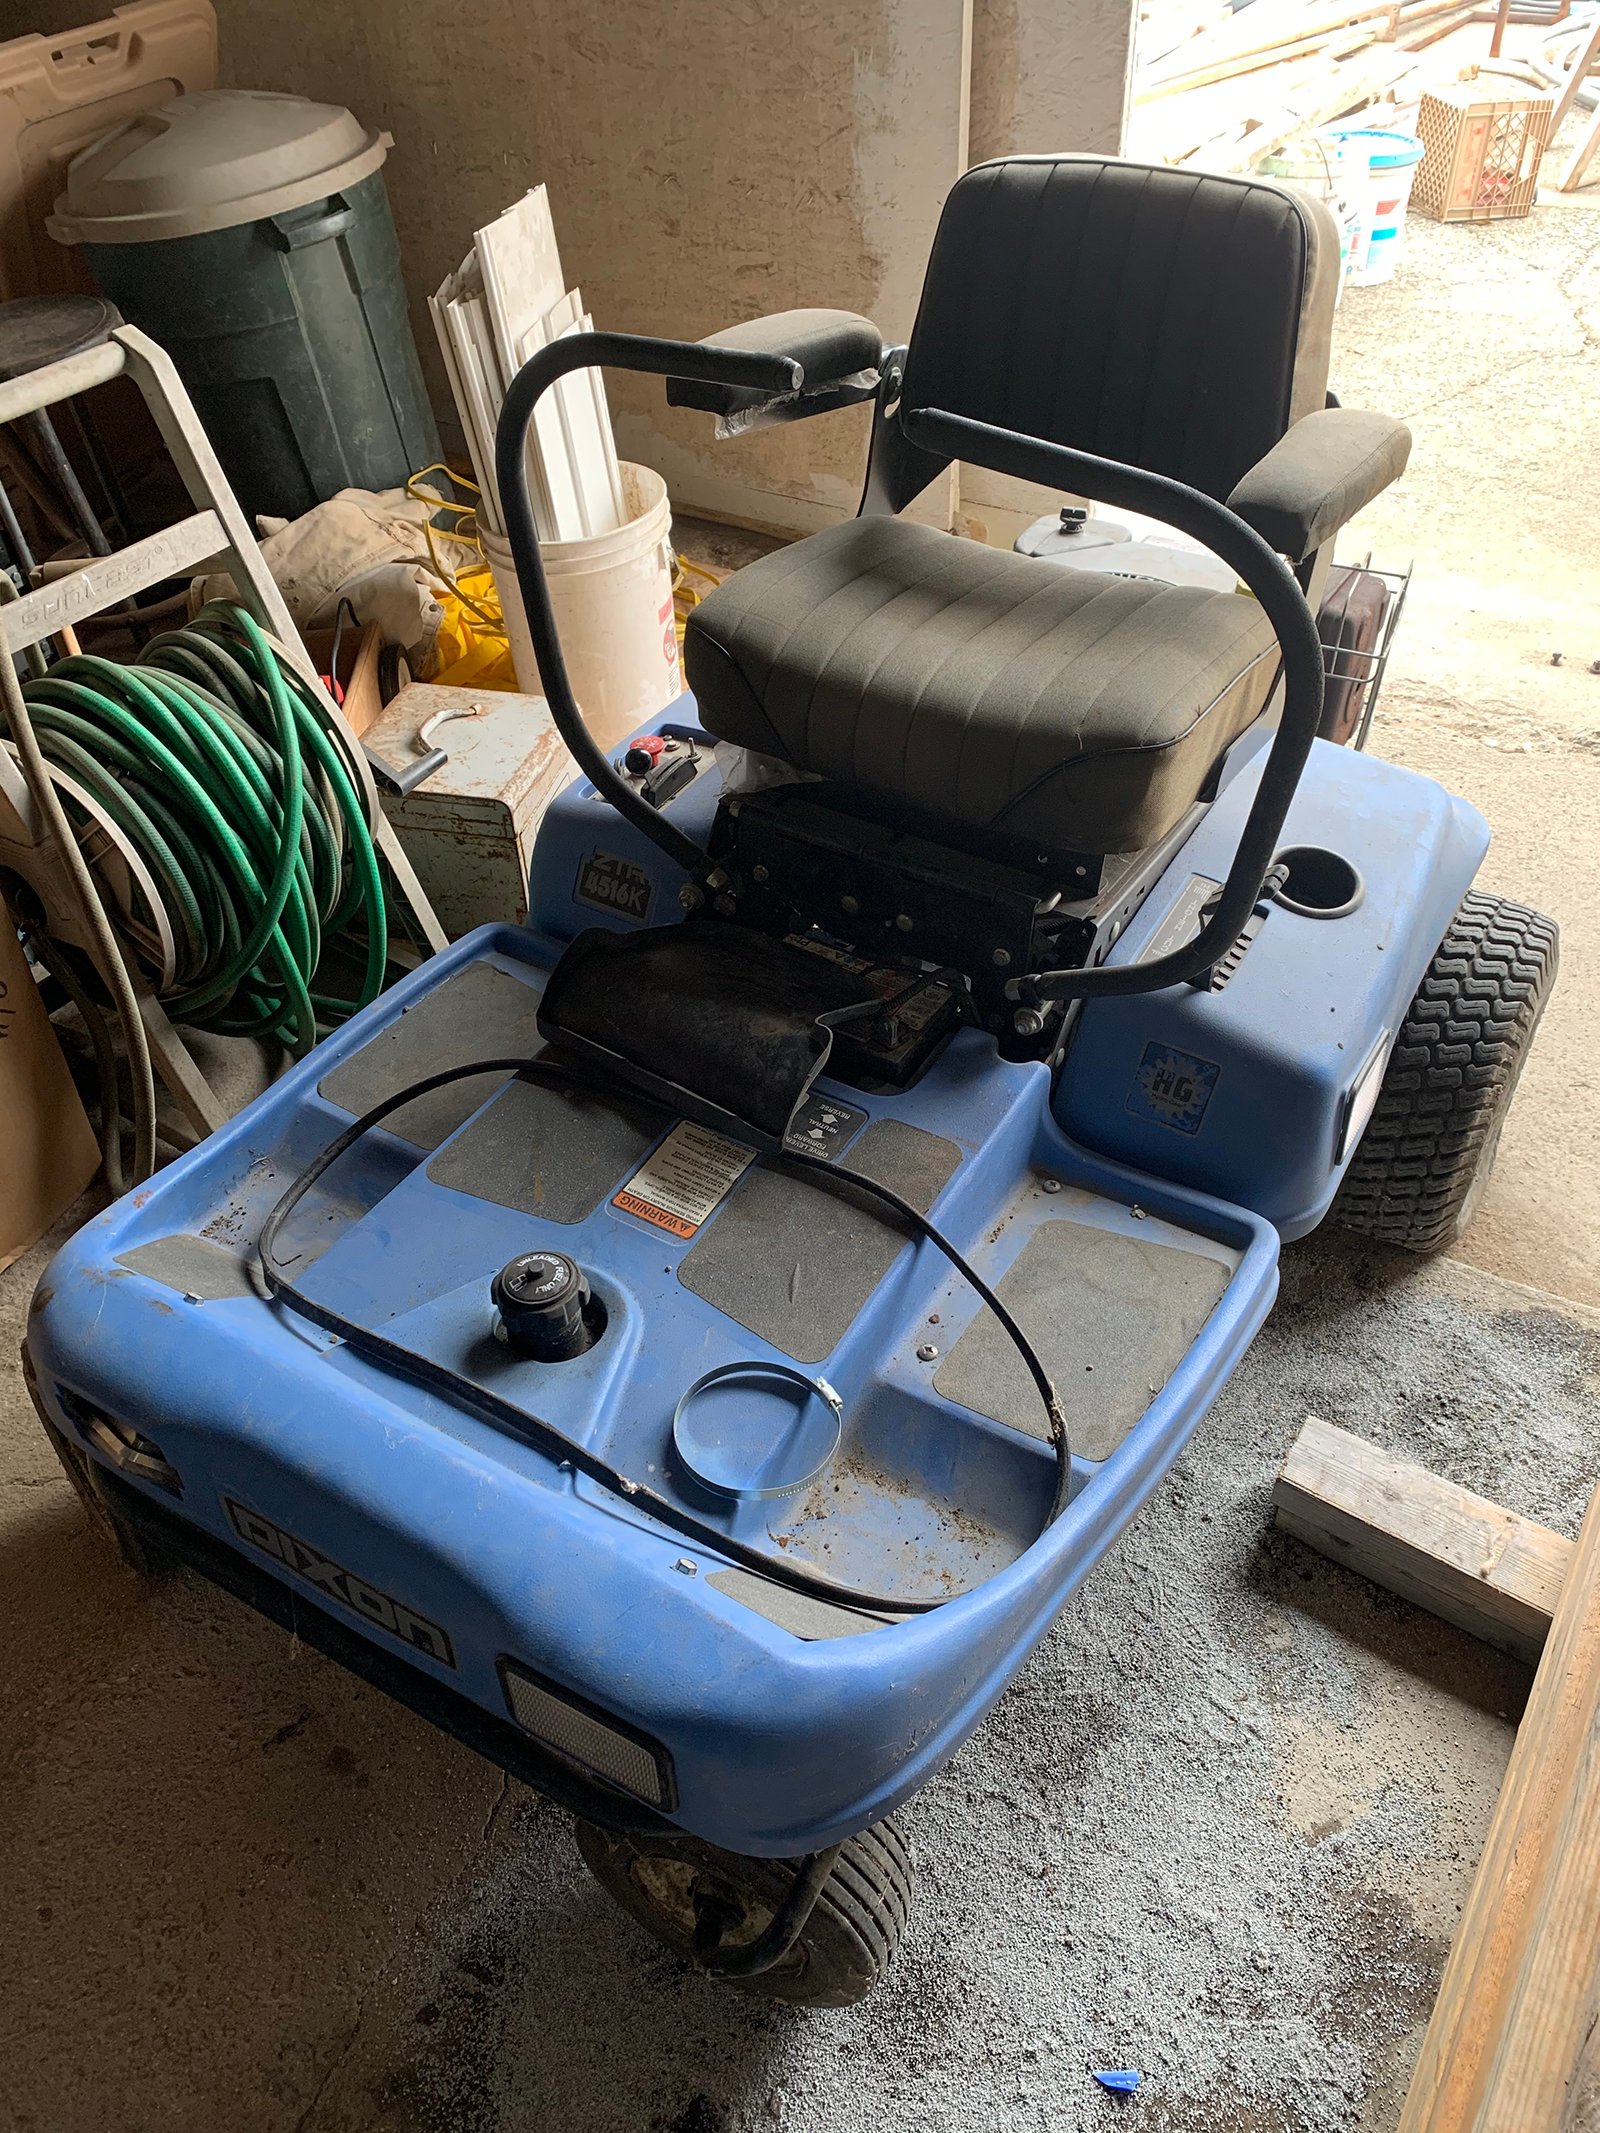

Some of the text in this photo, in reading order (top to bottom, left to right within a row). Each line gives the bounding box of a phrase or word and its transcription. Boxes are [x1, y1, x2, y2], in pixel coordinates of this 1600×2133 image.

[584, 871, 647, 911] 4516K
[1152, 1069, 1194, 1103] HG
[818, 1102, 851, 1120] REVERSE
[806, 1117, 839, 1134] NEUTRAL
[791, 1132, 827, 1150] FORWARD
[805, 1145, 829, 1158] DRIVE
[617, 1194, 680, 1229] WARNING
[516, 1254, 560, 1268] UNLEADED
[553, 1266, 564, 1282] FUEL
[535, 1281, 556, 1294] ONLY
